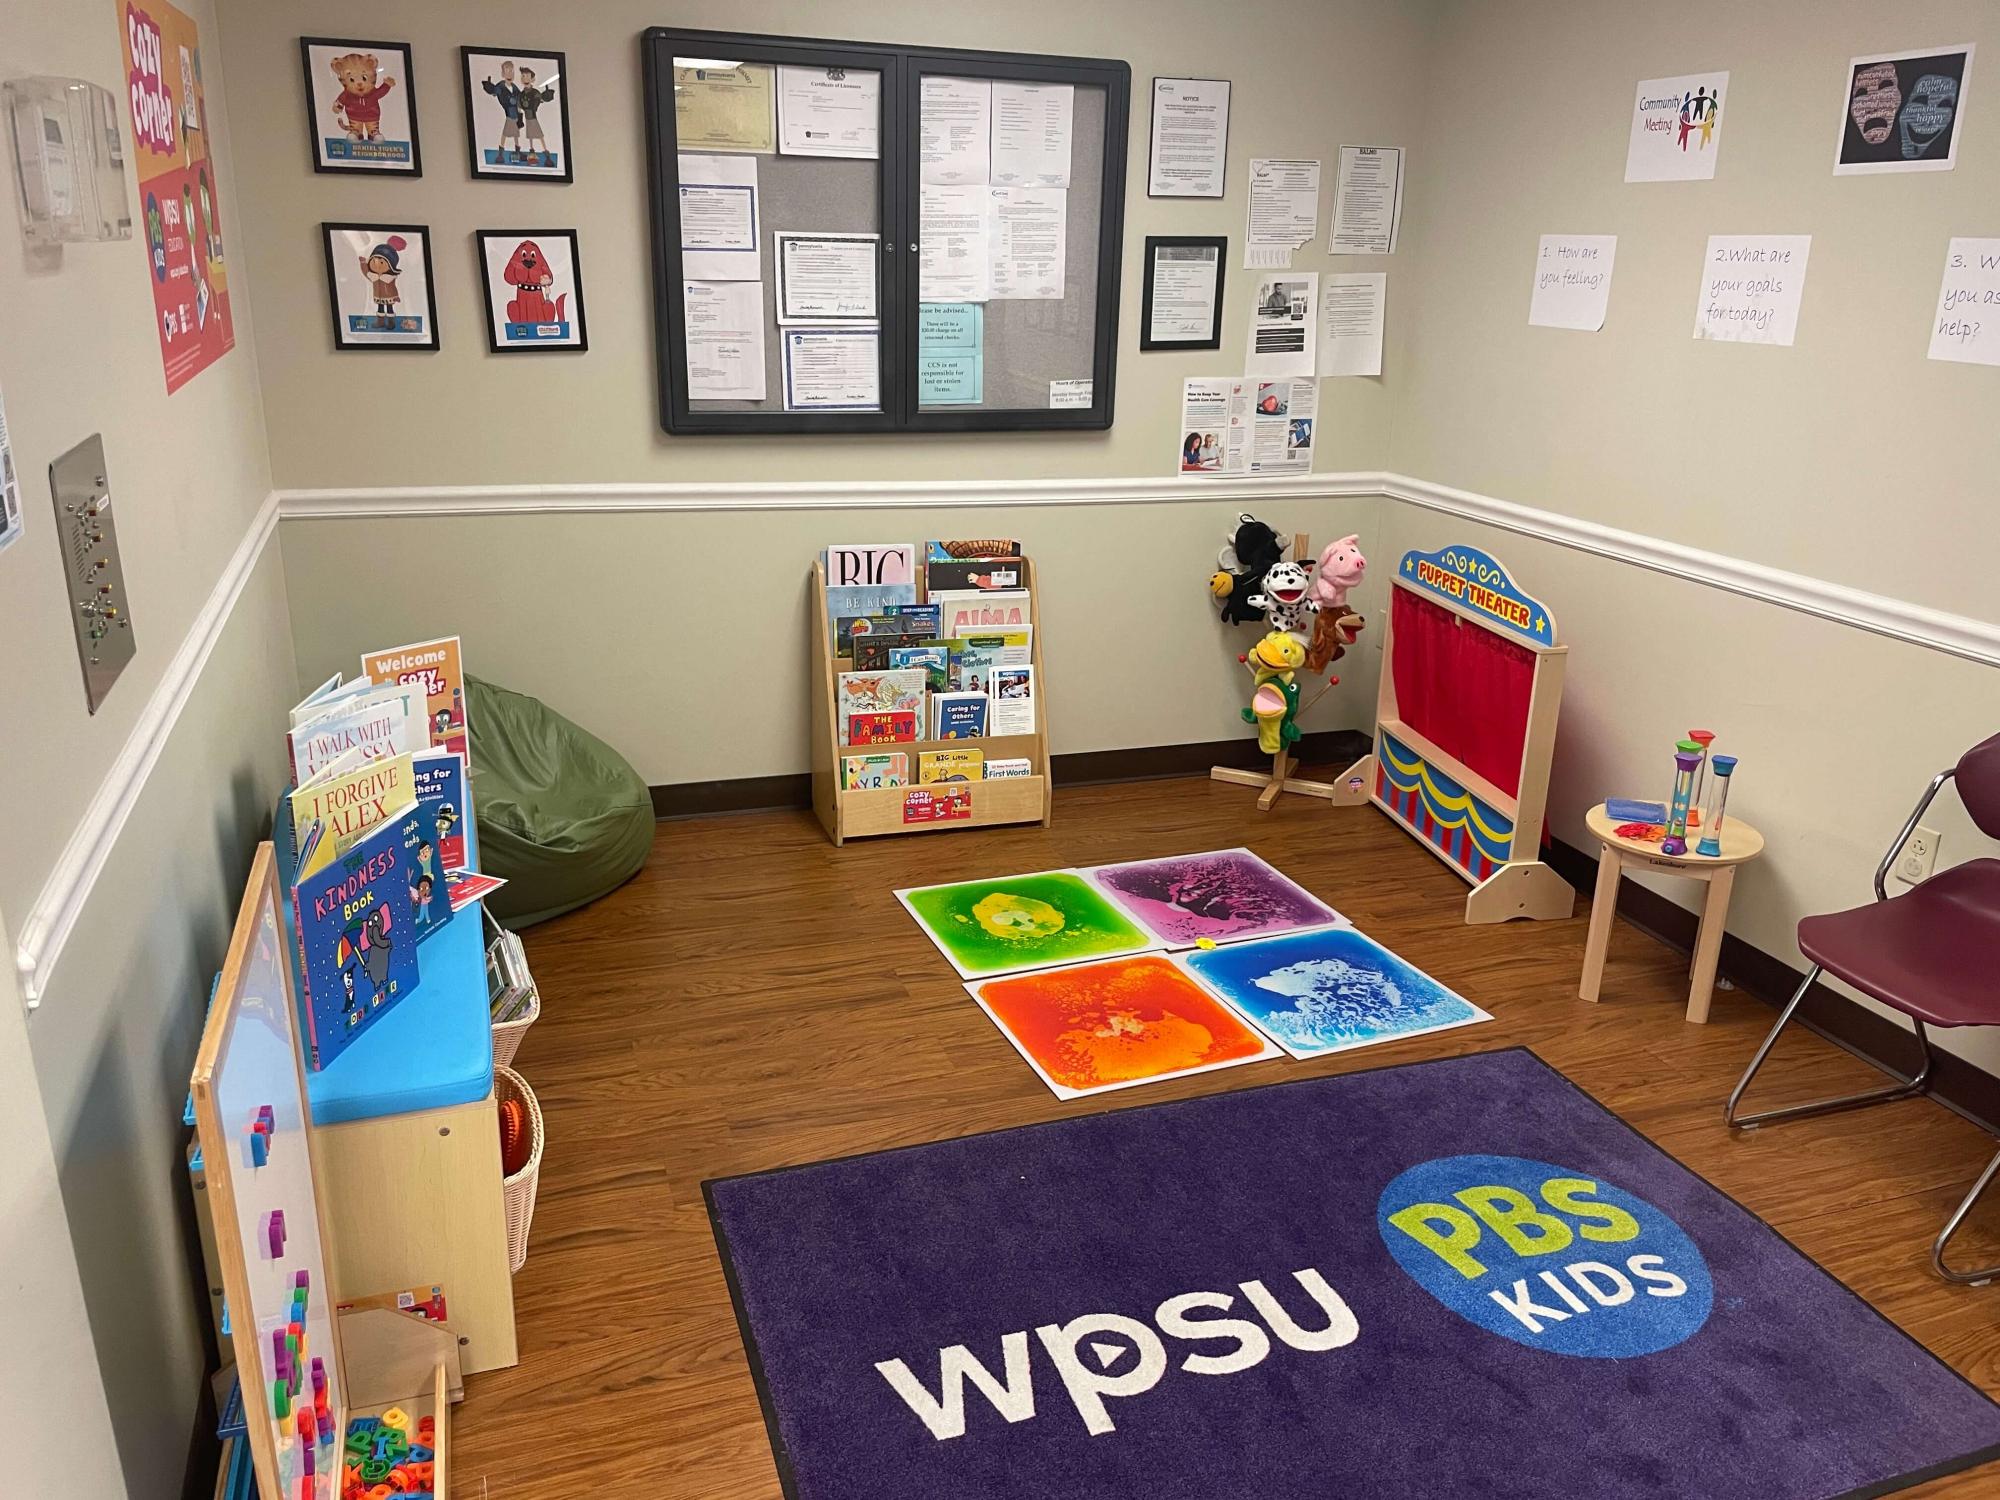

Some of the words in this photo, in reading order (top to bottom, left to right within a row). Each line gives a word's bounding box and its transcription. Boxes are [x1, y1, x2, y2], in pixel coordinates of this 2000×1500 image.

[1639, 94, 1682, 113] Community
[1643, 117, 1673, 136] Meeting
[1543, 246, 1551, 258] 1.
[1557, 246, 1580, 259] How
[1581, 247, 1599, 260] are
[1769, 249, 1791, 264] are
[1950, 254, 1967, 269] 3.
[1539, 271, 1560, 290] you
[1562, 268, 1604, 290] feeling?
[1710, 279, 1744, 299] your
[1746, 276, 1783, 297] goals
[1943, 288, 1978, 311] you
[1706, 302, 1726, 324] for
[1728, 305, 1775, 330] today?
[1938, 317, 1981, 345] help?
[846, 597, 860, 609] BE
[1417, 560, 1468, 599] PUPPET
[1468, 582, 1531, 630] THEATER
[892, 608, 897, 616] 2
[375, 649, 447, 675] Welcome
[947, 705, 969, 714] Caring
[853, 718, 913, 737] FAMILY
[873, 715, 893, 724] THE
[315, 729, 356, 756] WALK
[357, 716, 393, 741] WITH
[871, 735, 897, 744] BOOK
[935, 754, 950, 762] BIG
[413, 771, 431, 784] ing
[433, 768, 452, 779] for
[989, 770, 1005, 778] First
[1006, 768, 1030, 777] Words
[313, 797, 321, 818] I
[326, 766, 400, 815] FORGIVE
[850, 778, 869, 790] MY
[905, 797, 933, 805] corner
[909, 791, 930, 799] cozy
[330, 795, 389, 838] ALEX
[313, 846, 397, 922] KINDNESS
[343, 890, 375, 921] BOOK
[1386, 1175, 1643, 1283] PBS
[1486, 1253, 1691, 1336] KIDS
[872, 1266, 1361, 1443] wpsu
